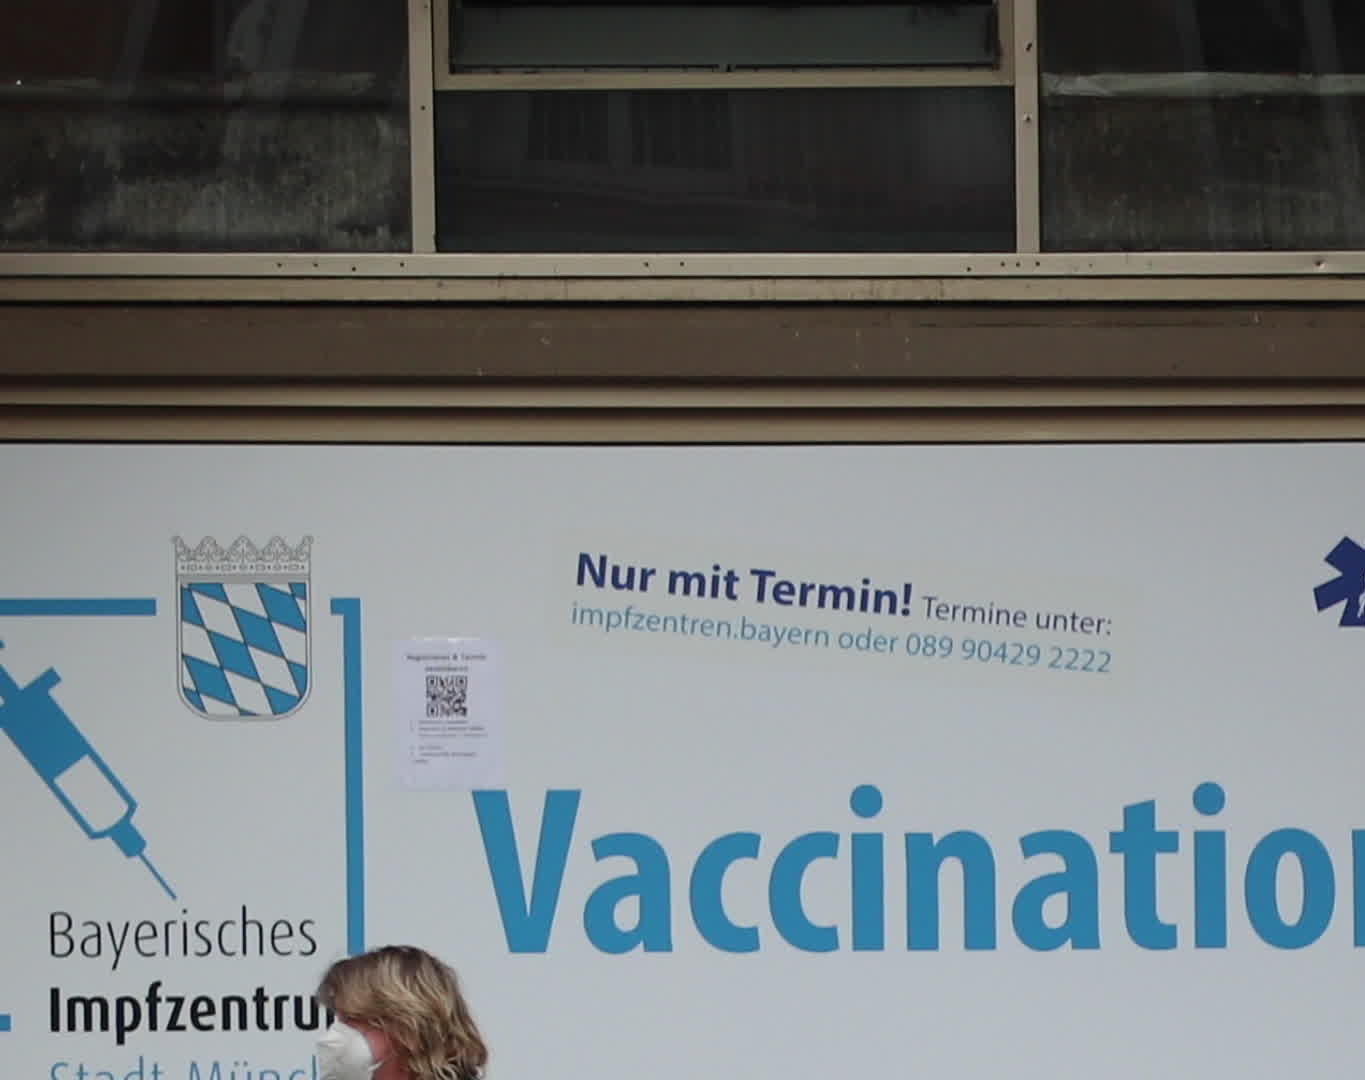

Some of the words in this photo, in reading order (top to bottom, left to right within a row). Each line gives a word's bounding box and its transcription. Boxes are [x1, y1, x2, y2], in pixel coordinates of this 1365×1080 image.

[575, 552, 656, 592] Nur
[667, 563, 740, 602] mit
[750, 568, 912, 617] Termin!
[921, 596, 1027, 628] Termine
[1035, 609, 1112, 637] unter:
[571, 601, 829, 648] impfzentren.bayern
[838, 627, 899, 654] oder
[905, 632, 954, 660] 089
[961, 637, 1041, 668] 90429
[1048, 646, 1112, 675] 2222
[48, 904, 318, 971] Bayerisches
[50, 980, 336, 1046] Impfzentru
